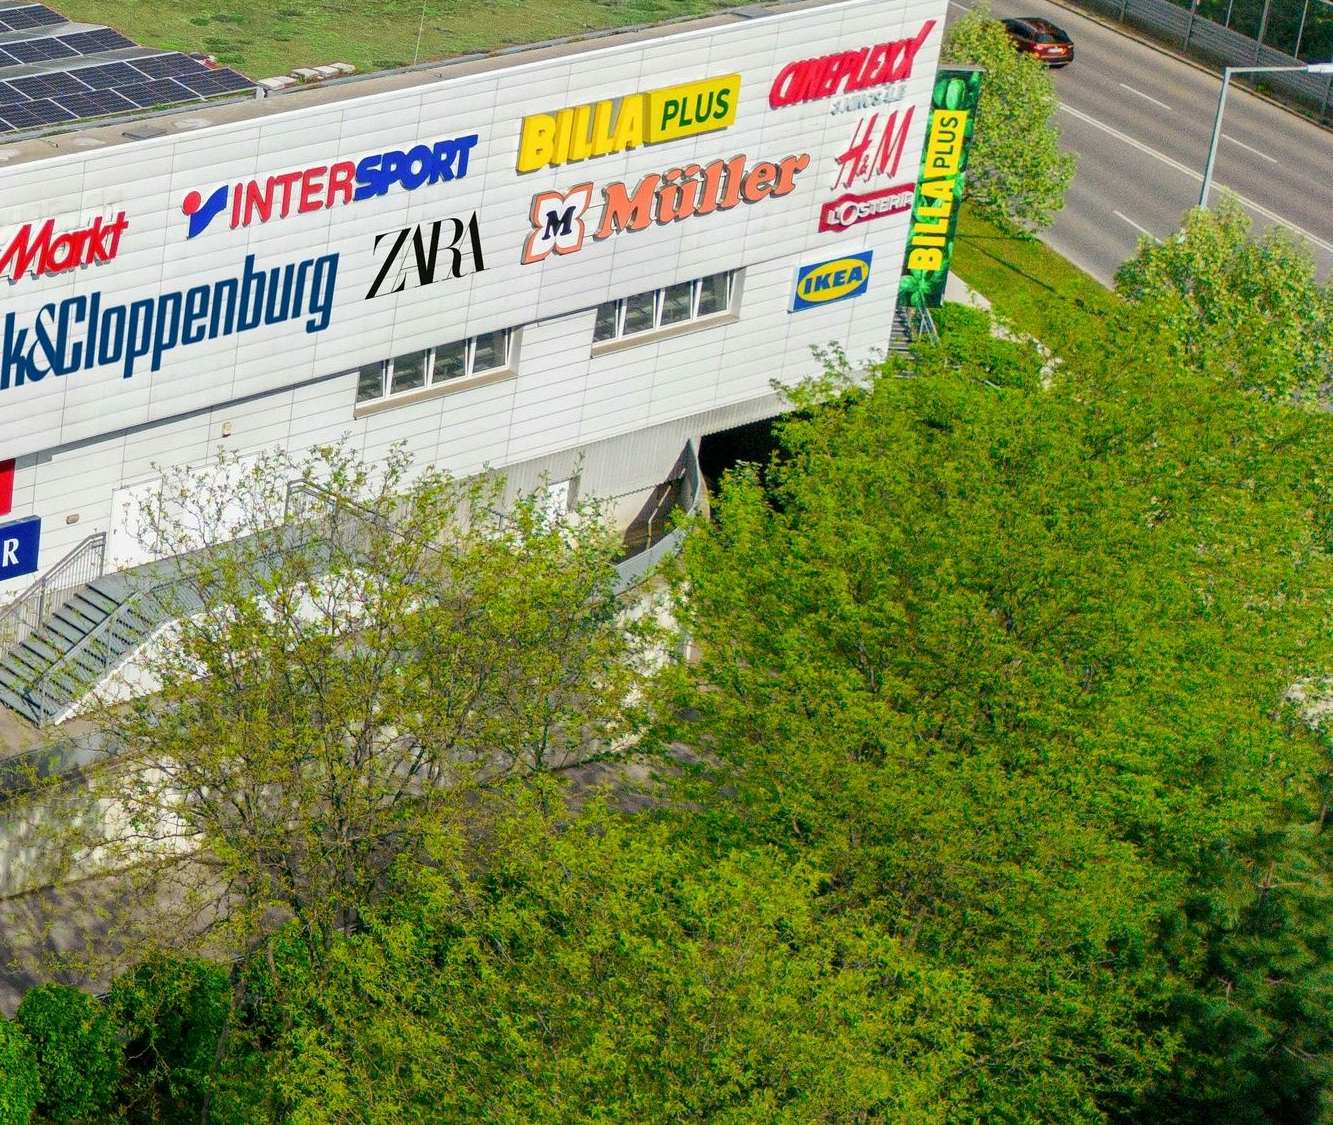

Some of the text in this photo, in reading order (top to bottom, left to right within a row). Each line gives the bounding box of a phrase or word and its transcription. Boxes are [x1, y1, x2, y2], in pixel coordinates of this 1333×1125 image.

[769, 19, 937, 109] CINEPLEXX
[517, 87, 731, 174] BILLA PLUS
[831, 105, 915, 191] H&M
[230, 134, 478, 230] INTERSPORT
[593, 153, 811, 241] Müller
[907, 115, 960, 272] BILLA PLUS
[365, 210, 491, 300] ZARA
[803, 266, 864, 296] IKEA
